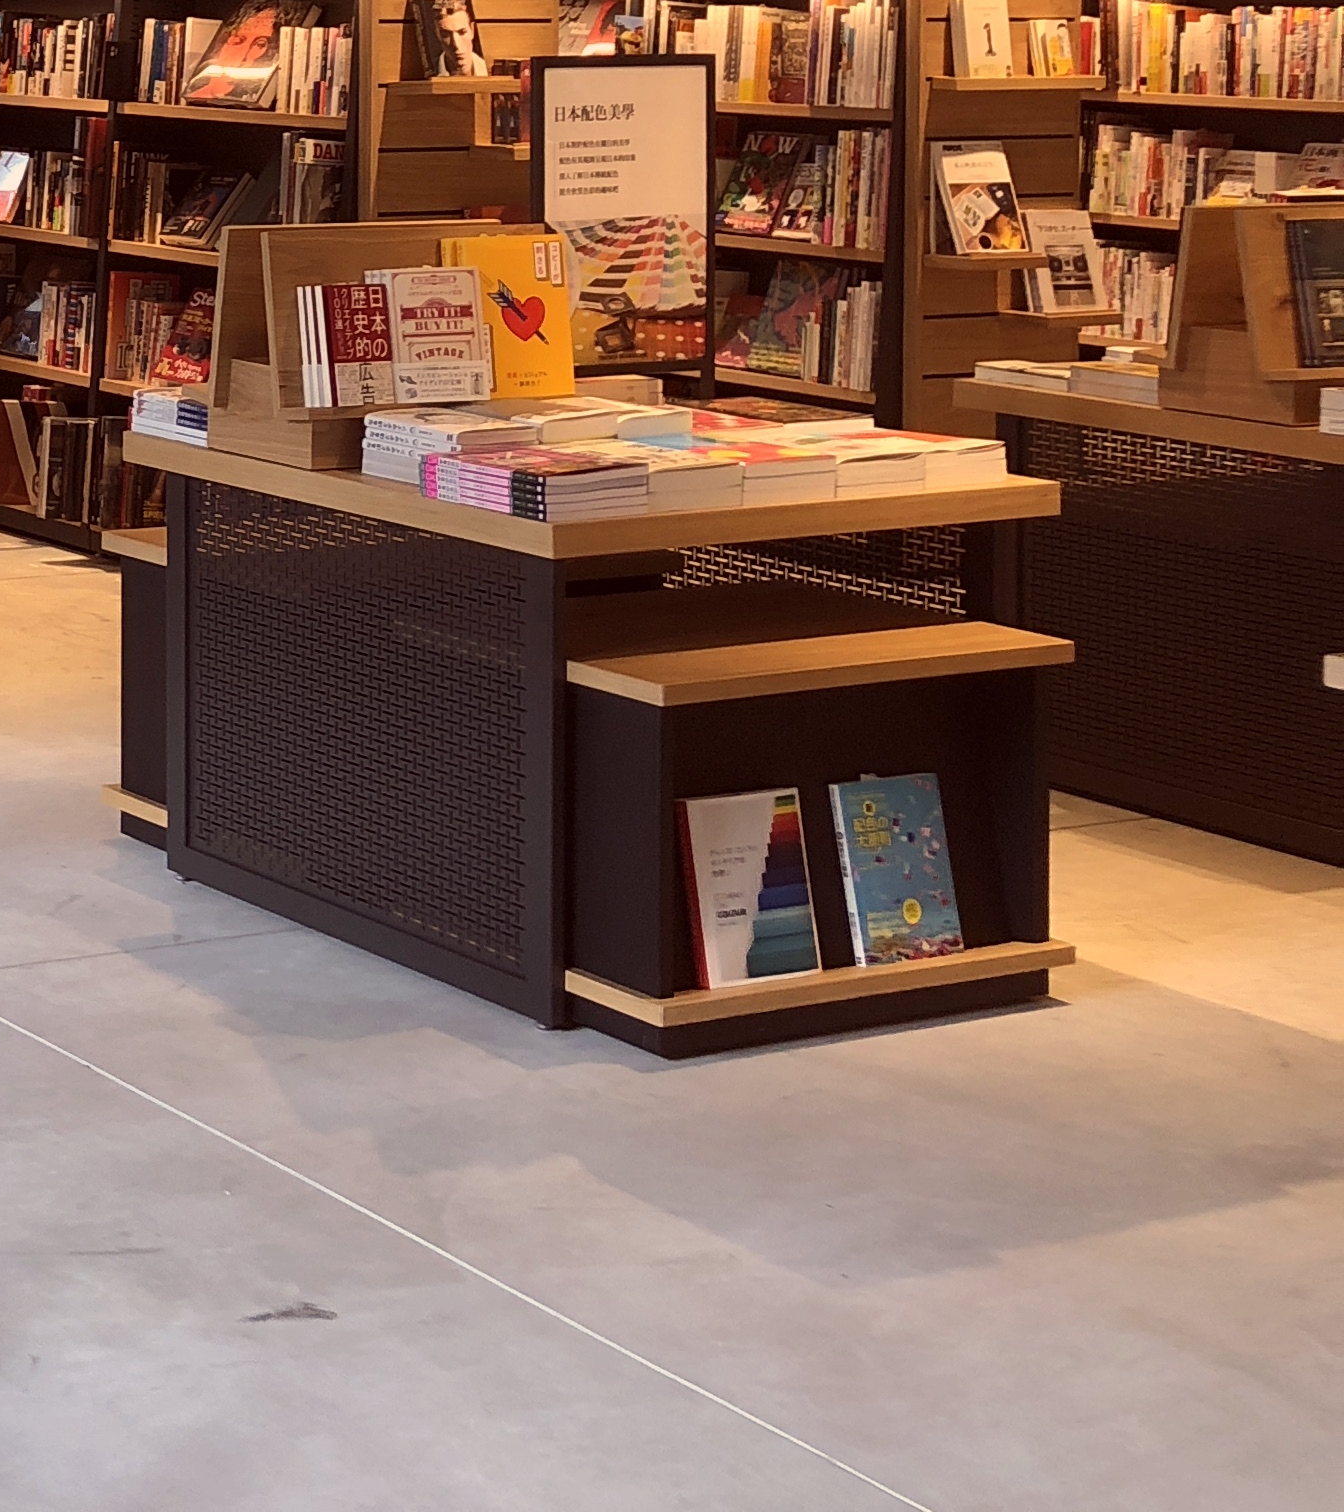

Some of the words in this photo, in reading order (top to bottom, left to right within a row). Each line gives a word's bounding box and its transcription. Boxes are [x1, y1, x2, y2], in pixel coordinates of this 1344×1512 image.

[554, 103, 635, 123] 日本配色美學
[414, 307, 440, 319] TRY
[443, 306, 462, 318] IT!
[368, 286, 389, 358] 日本の
[414, 321, 441, 331] BUY
[446, 320, 464, 330] IT!
[414, 346, 465, 361] VINTAGE
